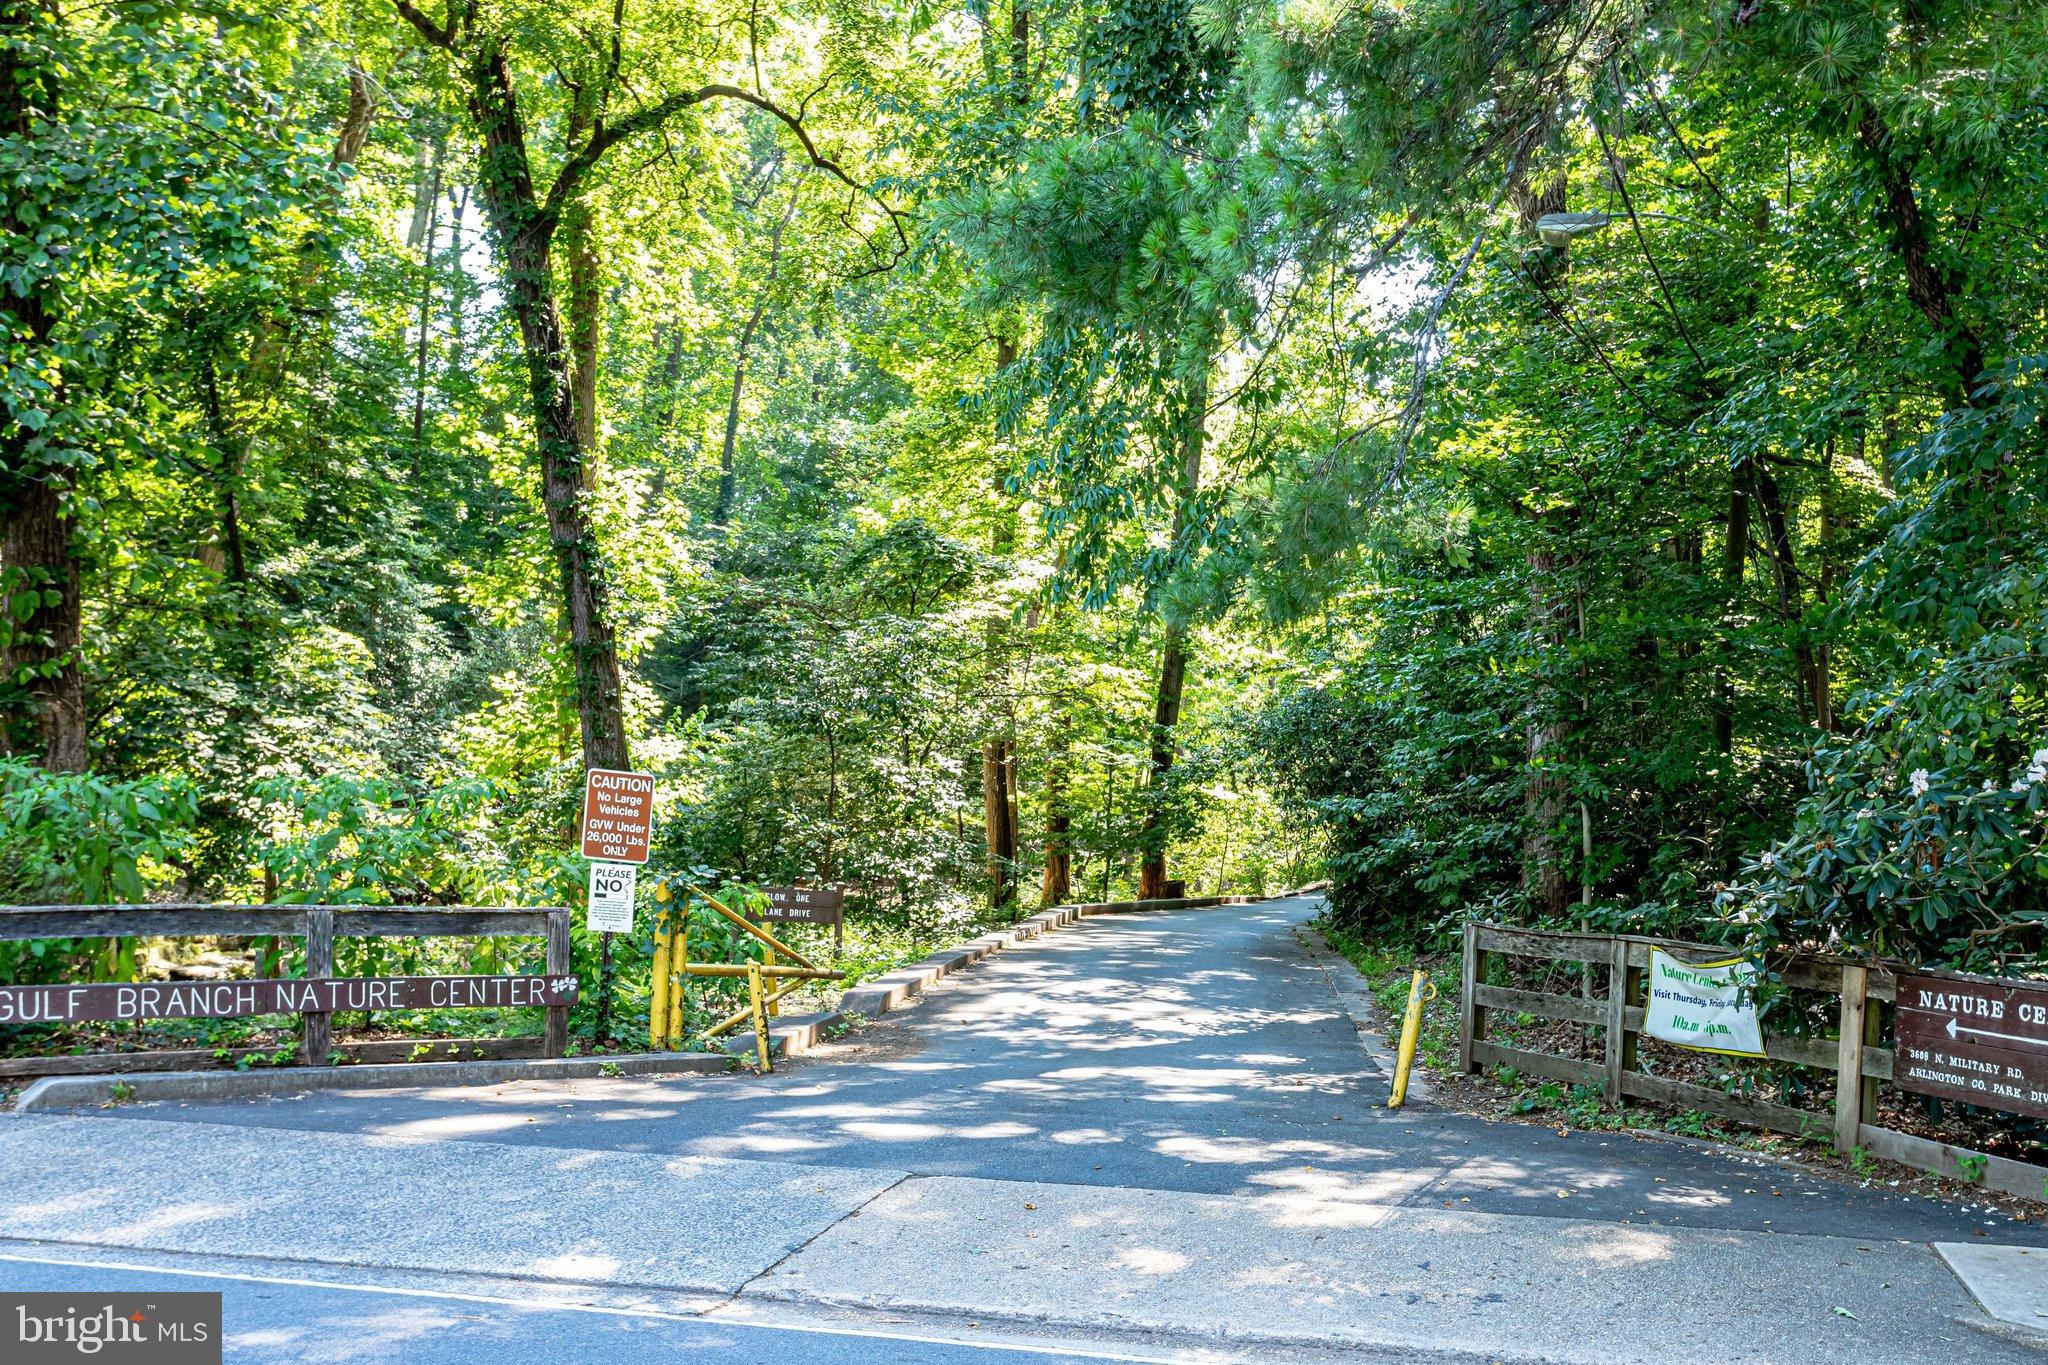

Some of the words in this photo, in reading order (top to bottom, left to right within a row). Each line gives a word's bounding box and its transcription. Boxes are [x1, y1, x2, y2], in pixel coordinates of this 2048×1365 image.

[591, 774, 651, 792] CAUTION
[597, 791, 611, 802] No
[615, 793, 643, 806] Large
[599, 803, 639, 817] Vehicles
[589, 819, 613, 830] GVW
[617, 821, 646, 833] Under
[586, 831, 622, 843] 26,000
[625, 835, 646, 846] Lbs.
[602, 844, 628, 857] ONLY
[595, 868, 632, 879] PLEASE
[596, 879, 623, 892] NO
[796, 894, 810, 903] ONE
[764, 908, 783, 917] LANE
[789, 909, 811, 918] DRIVE
[1660, 963, 1692, 983] Nature
[0, 989, 88, 1021] GULF
[117, 985, 255, 1018] BRANCH
[276, 980, 406, 1010] NATURE
[430, 978, 546, 1006] CENTER
[1654, 988, 1671, 1000] Visit
[1673, 992, 1707, 1008] Thursday,
[1919, 990, 2004, 1019] NATURE
[2018, 1003, 2048, 1025] CE
[1934, 1053, 1944, 1065] N.
[1949, 1056, 2000, 1075] MILITARY
[1909, 1066, 1965, 1086] ARLINGTON
[1971, 1079, 1987, 1091] CO.
[1992, 1083, 2022, 1099] PARK
